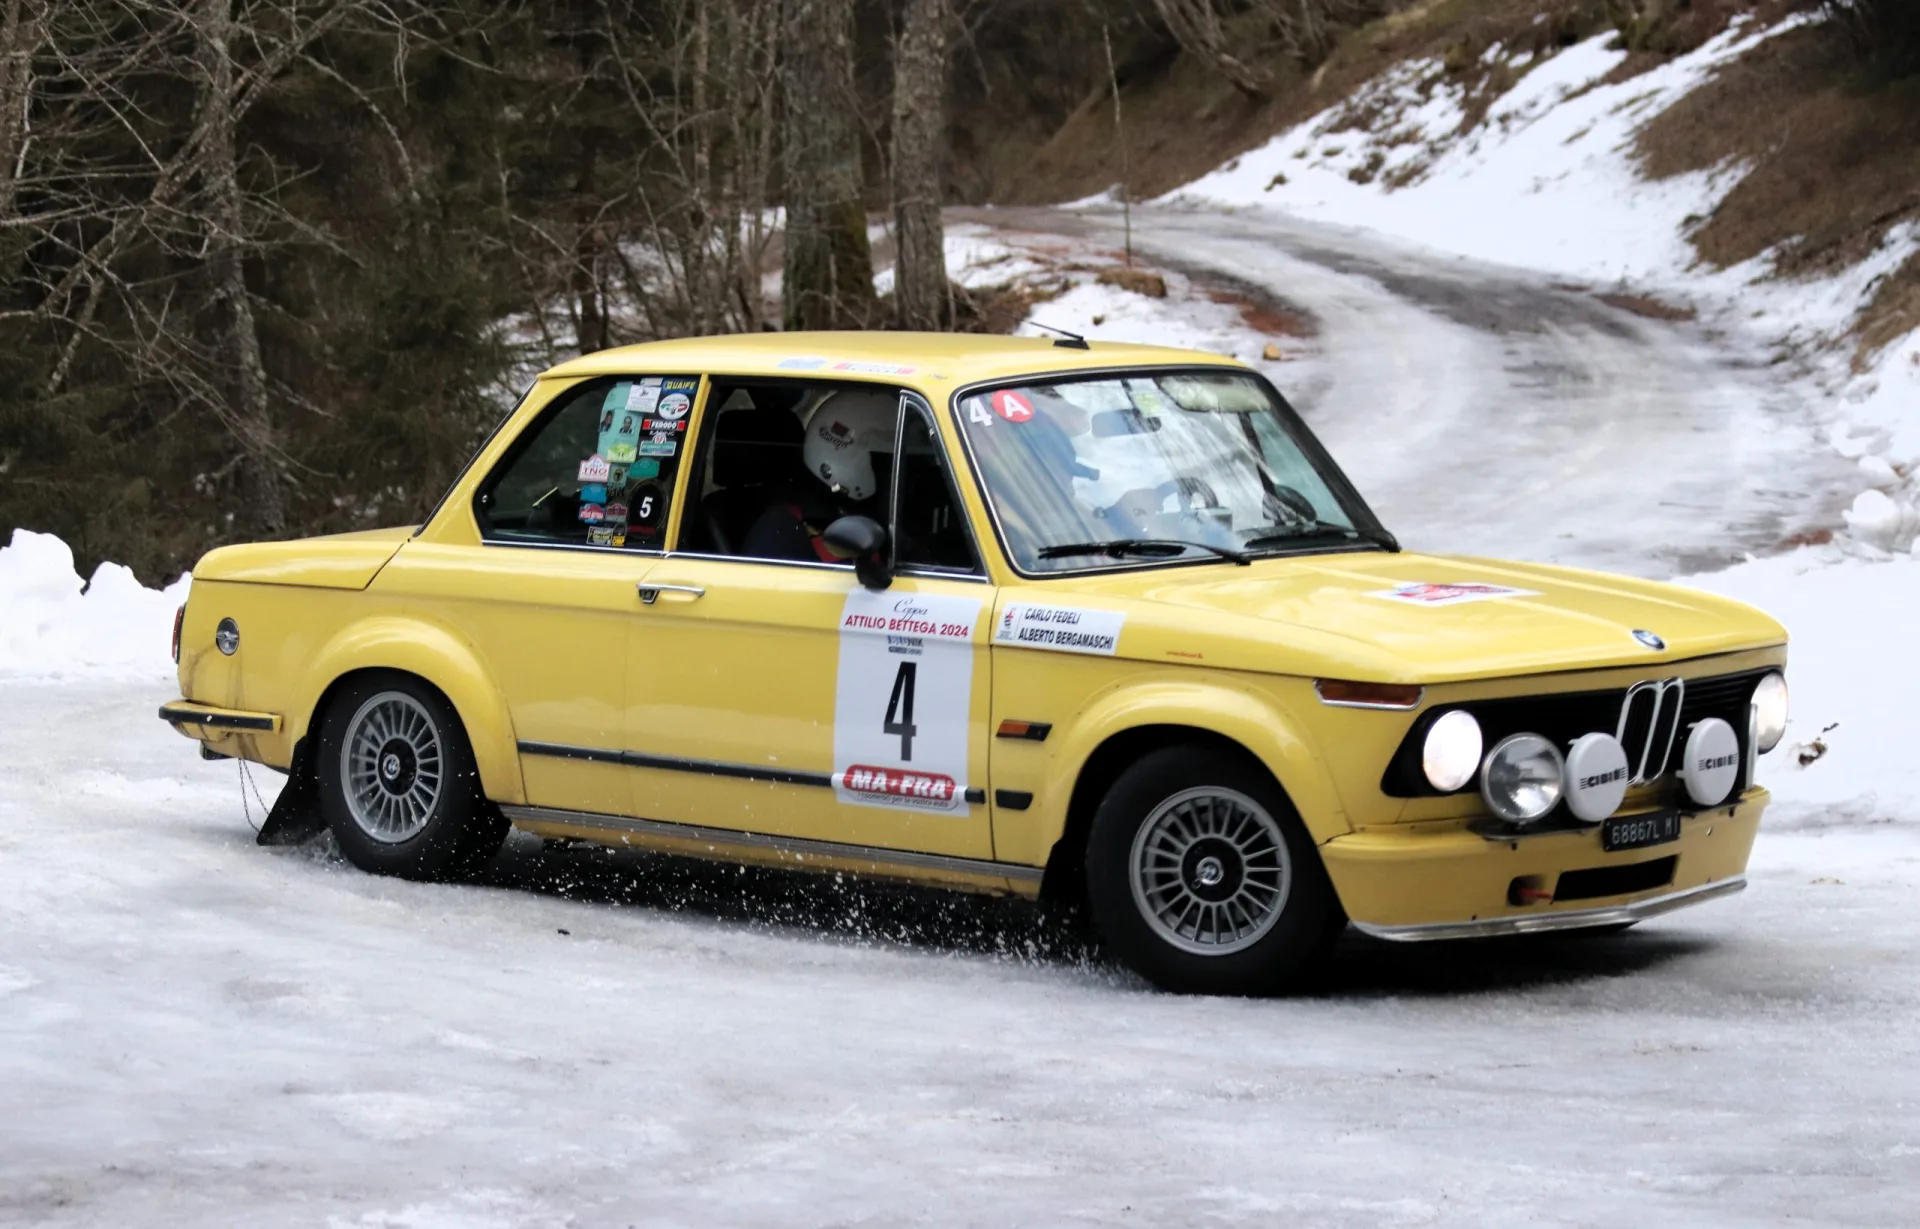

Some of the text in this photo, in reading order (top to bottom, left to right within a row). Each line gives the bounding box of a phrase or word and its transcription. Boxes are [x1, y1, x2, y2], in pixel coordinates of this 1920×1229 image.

[666, 381, 696, 390] QUAIFE
[969, 394, 1030, 428] 4 A
[651, 420, 677, 429] FERODO
[639, 496, 654, 518] 5
[893, 599, 928, 622] Coppa
[1024, 608, 1082, 625] CARLO FEDELI
[844, 614, 969, 638] ATTILIO BETTEGA 2024
[1018, 627, 1055, 644] ALBERTO
[1055, 630, 1115, 650] BERGAMASCHI
[884, 660, 917, 762] 4
[1612, 820, 1660, 846] 68867L
